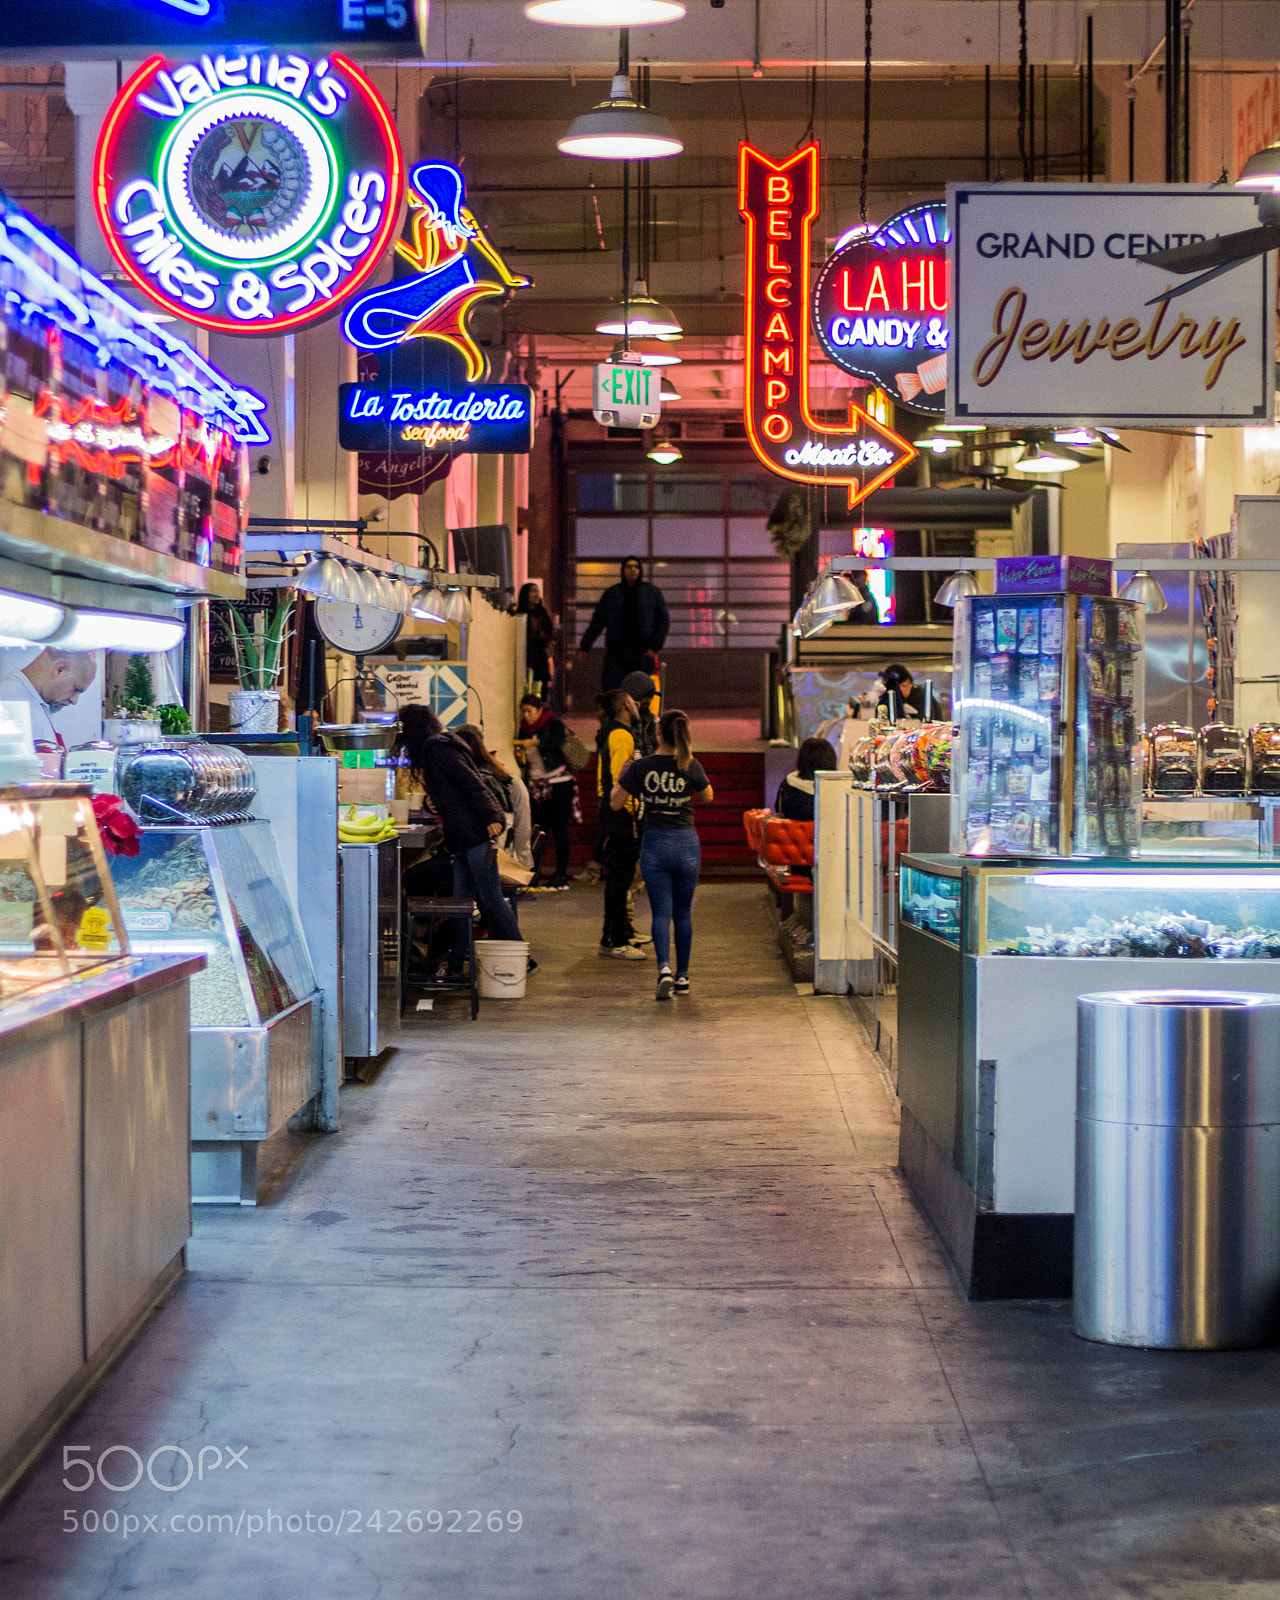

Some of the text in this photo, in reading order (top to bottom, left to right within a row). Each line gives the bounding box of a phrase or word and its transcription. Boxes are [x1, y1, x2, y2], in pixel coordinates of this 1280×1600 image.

[342, 0, 407, 29] E-5
[116, 171, 386, 320] Chiles & Spices
[976, 232, 1223, 260] GRAND CENT
[843, 264, 890, 312] LA
[763, 175, 795, 444] BELCAMPO
[831, 317, 949, 349] CANDY &
[972, 286, 1247, 391] Jewelry
[612, 368, 652, 406] EXIT
[350, 389, 384, 418] La
[401, 421, 472, 448] seafood
[785, 441, 857, 466] Meat
[644, 770, 687, 793] Olio
